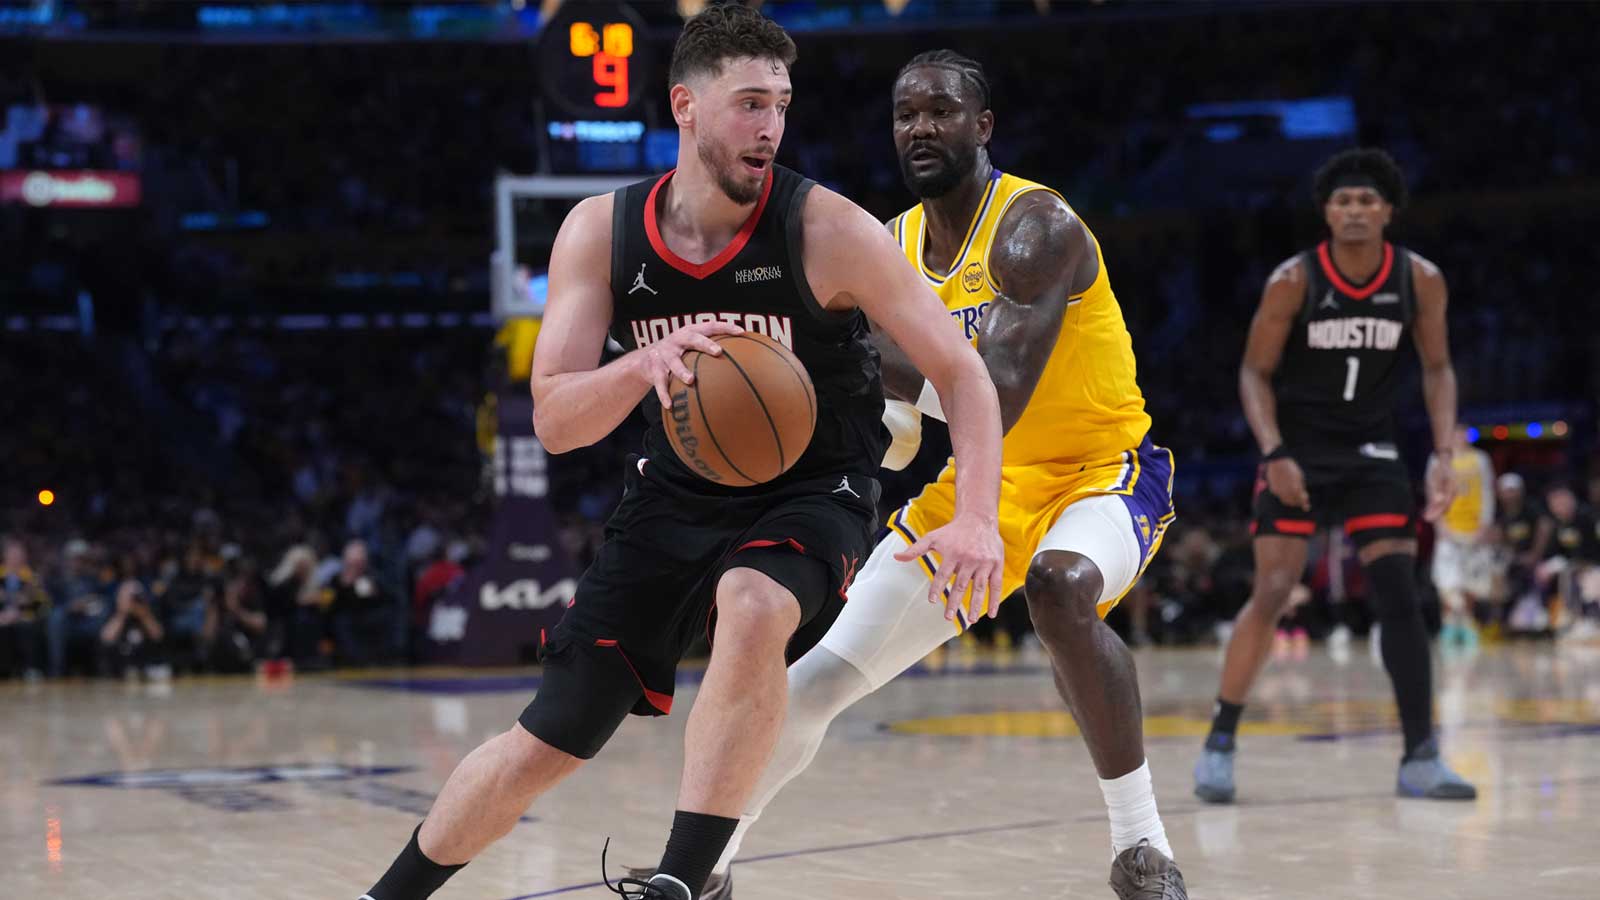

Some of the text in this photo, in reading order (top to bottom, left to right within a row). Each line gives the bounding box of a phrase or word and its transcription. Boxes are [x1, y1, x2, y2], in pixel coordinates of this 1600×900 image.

[592, 52, 629, 107] 9
[735, 266, 781, 278] MEMORIAL
[735, 271, 782, 284] HERMANN
[1308, 317, 1402, 350] HOUSTON
[1343, 356, 1360, 401] 1
